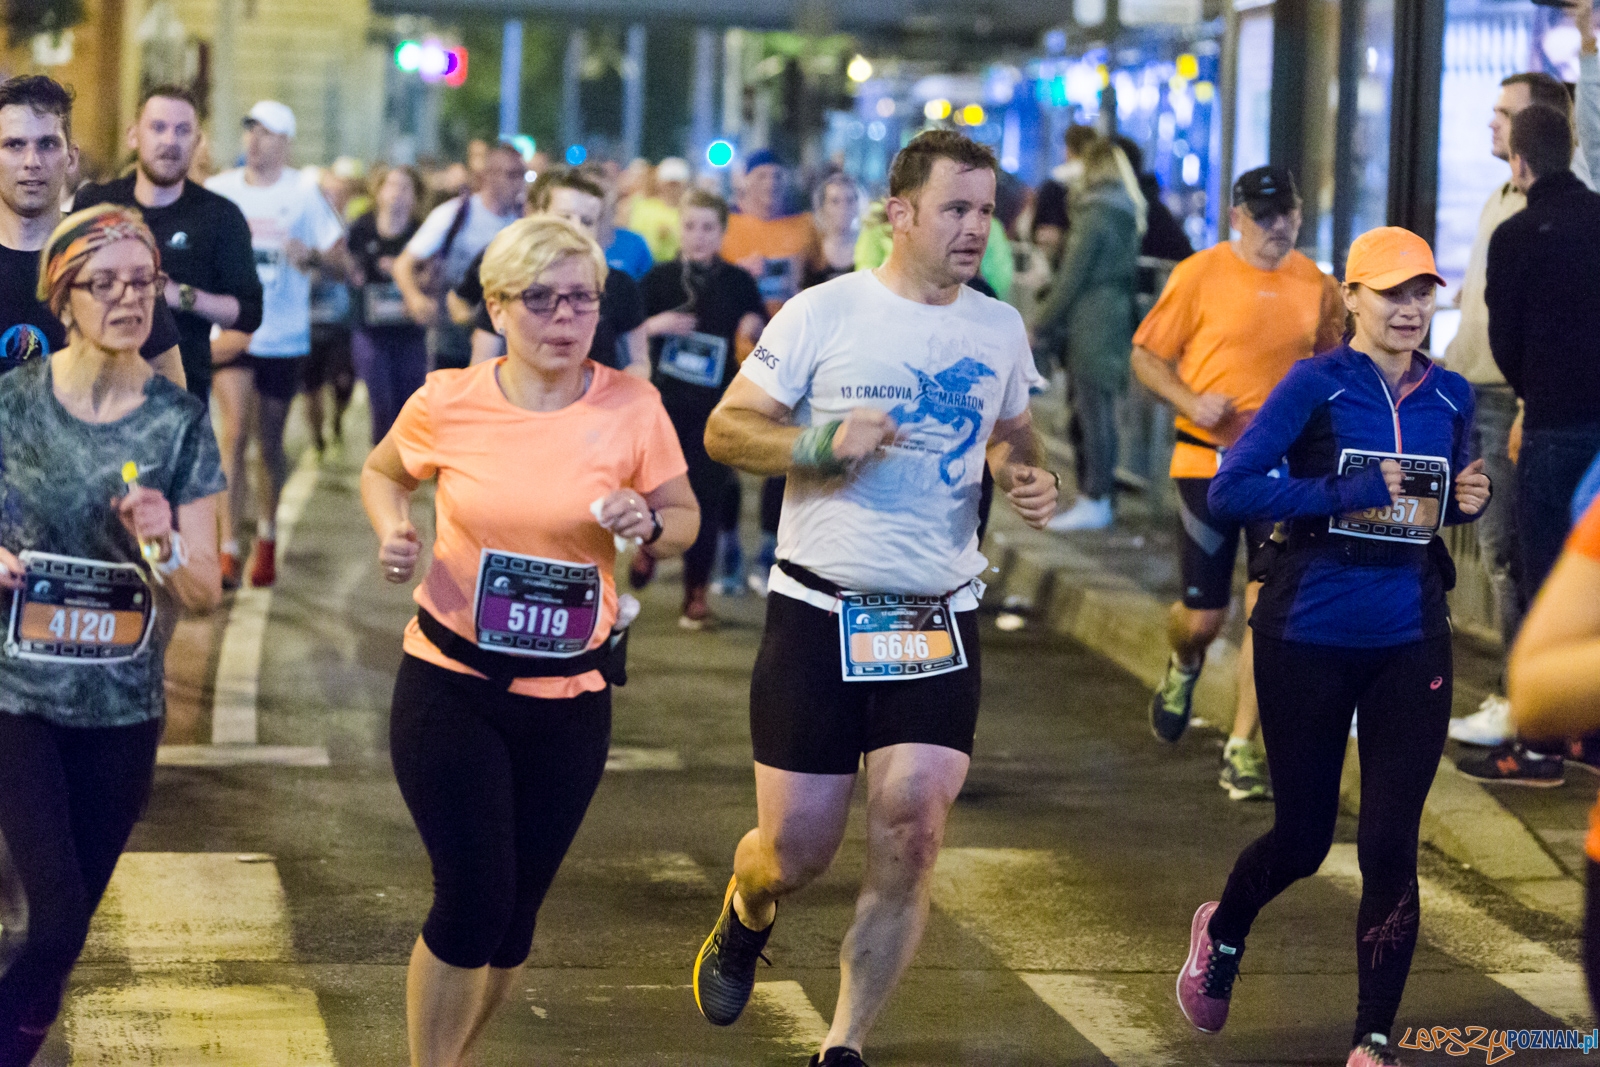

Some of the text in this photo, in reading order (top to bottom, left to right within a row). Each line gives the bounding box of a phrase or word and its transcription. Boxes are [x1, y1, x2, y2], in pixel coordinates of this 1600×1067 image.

[938, 391, 984, 411] MARATON
[49, 609, 116, 642] 4120
[507, 602, 569, 637] 5119
[872, 633, 929, 660] 6646
